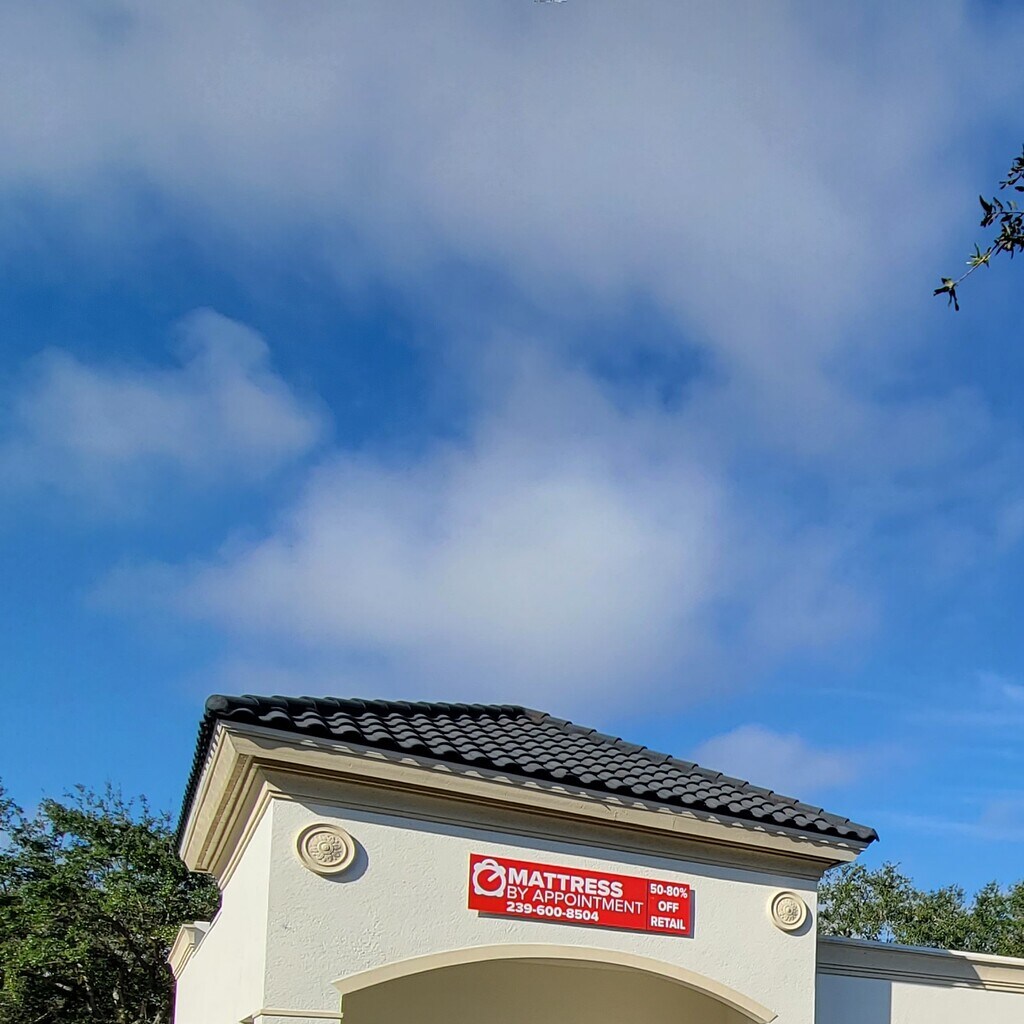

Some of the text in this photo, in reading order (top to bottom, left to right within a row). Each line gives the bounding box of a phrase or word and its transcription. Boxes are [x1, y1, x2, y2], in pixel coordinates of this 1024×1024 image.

[509, 868, 623, 897] MATTRESS
[650, 884, 688, 898] 50-80%
[508, 885, 644, 914] BY APPOINTMENT
[658, 900, 679, 914] OFF
[506, 902, 598, 921] 239-600-8504
[650, 917, 686, 930] RETAIL
